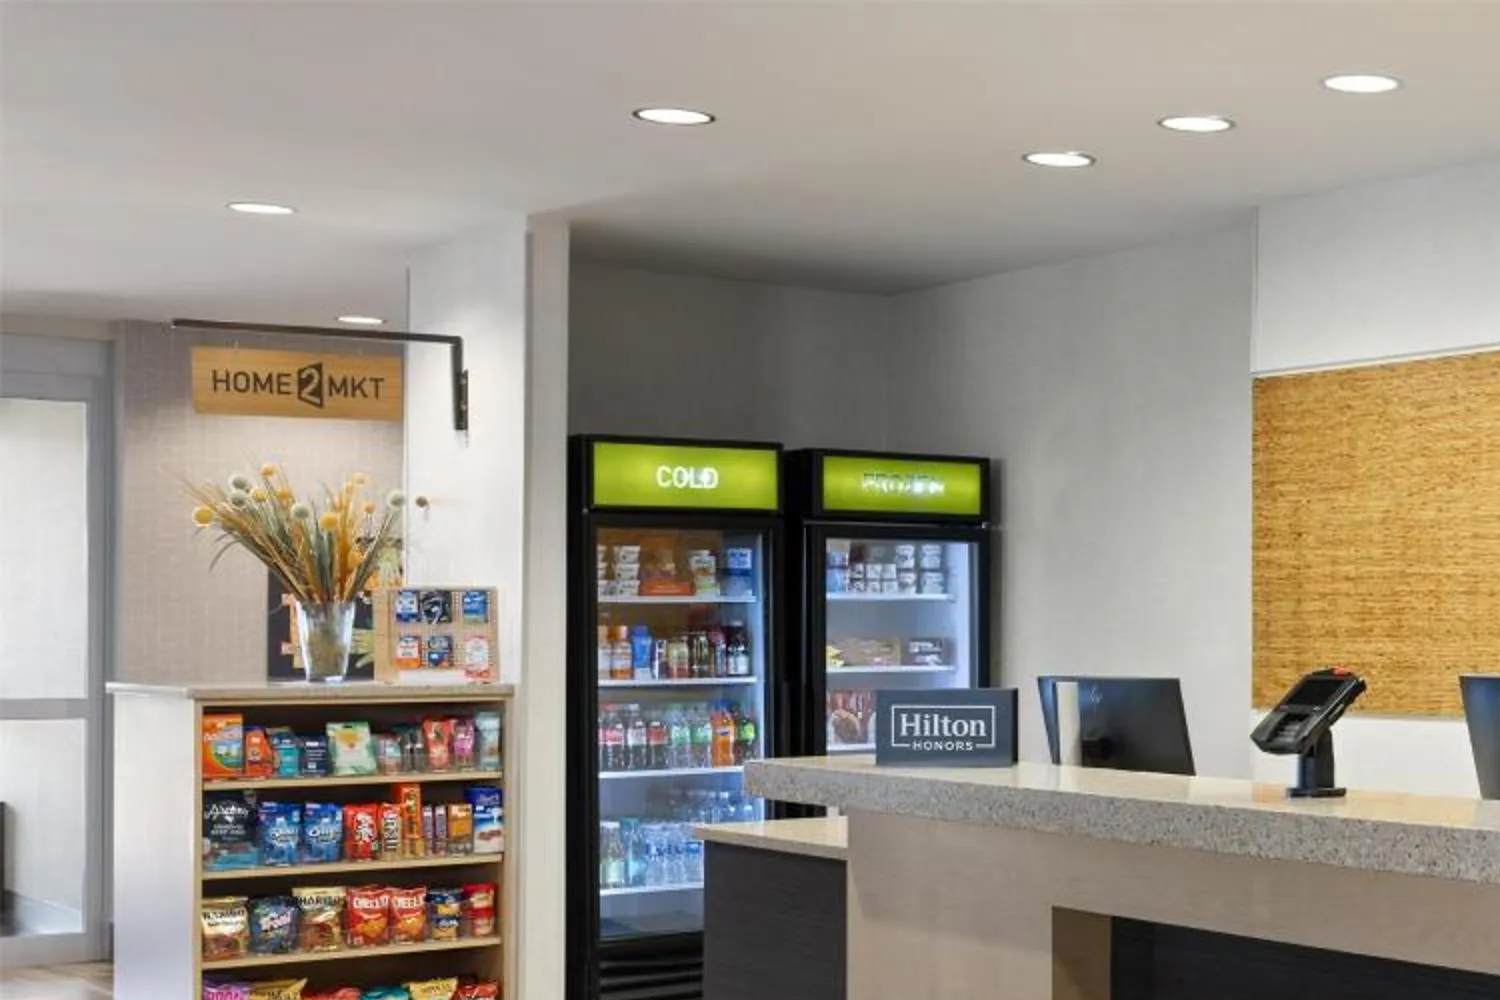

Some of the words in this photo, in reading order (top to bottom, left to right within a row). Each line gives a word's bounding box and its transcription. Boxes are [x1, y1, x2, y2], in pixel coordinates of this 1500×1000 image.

[656, 465, 719, 489] COLD
[899, 713, 987, 737] Hilton
[912, 740, 974, 751] HONORS
